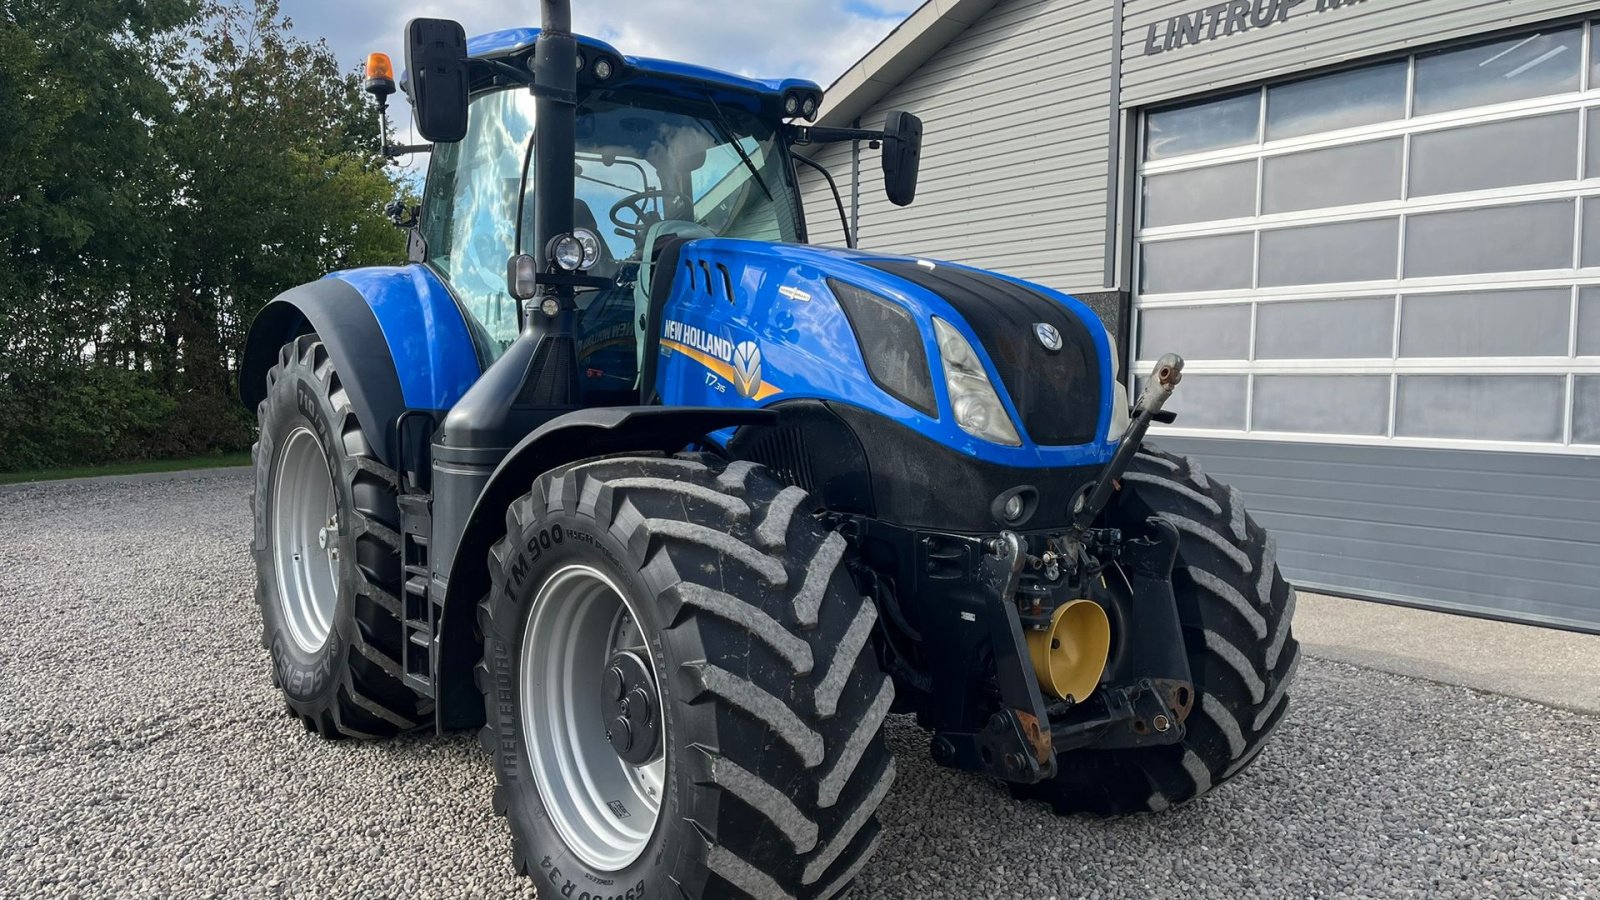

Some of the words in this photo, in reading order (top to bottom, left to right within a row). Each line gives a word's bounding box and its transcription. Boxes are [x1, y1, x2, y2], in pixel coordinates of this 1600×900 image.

[1143, 0, 1304, 56] LINTRUP
[664, 319, 683, 341] NEW
[683, 324, 732, 362] HOLLAND
[504, 552, 530, 602] TM
[527, 523, 563, 561] 900
[540, 855, 562, 886] 34
